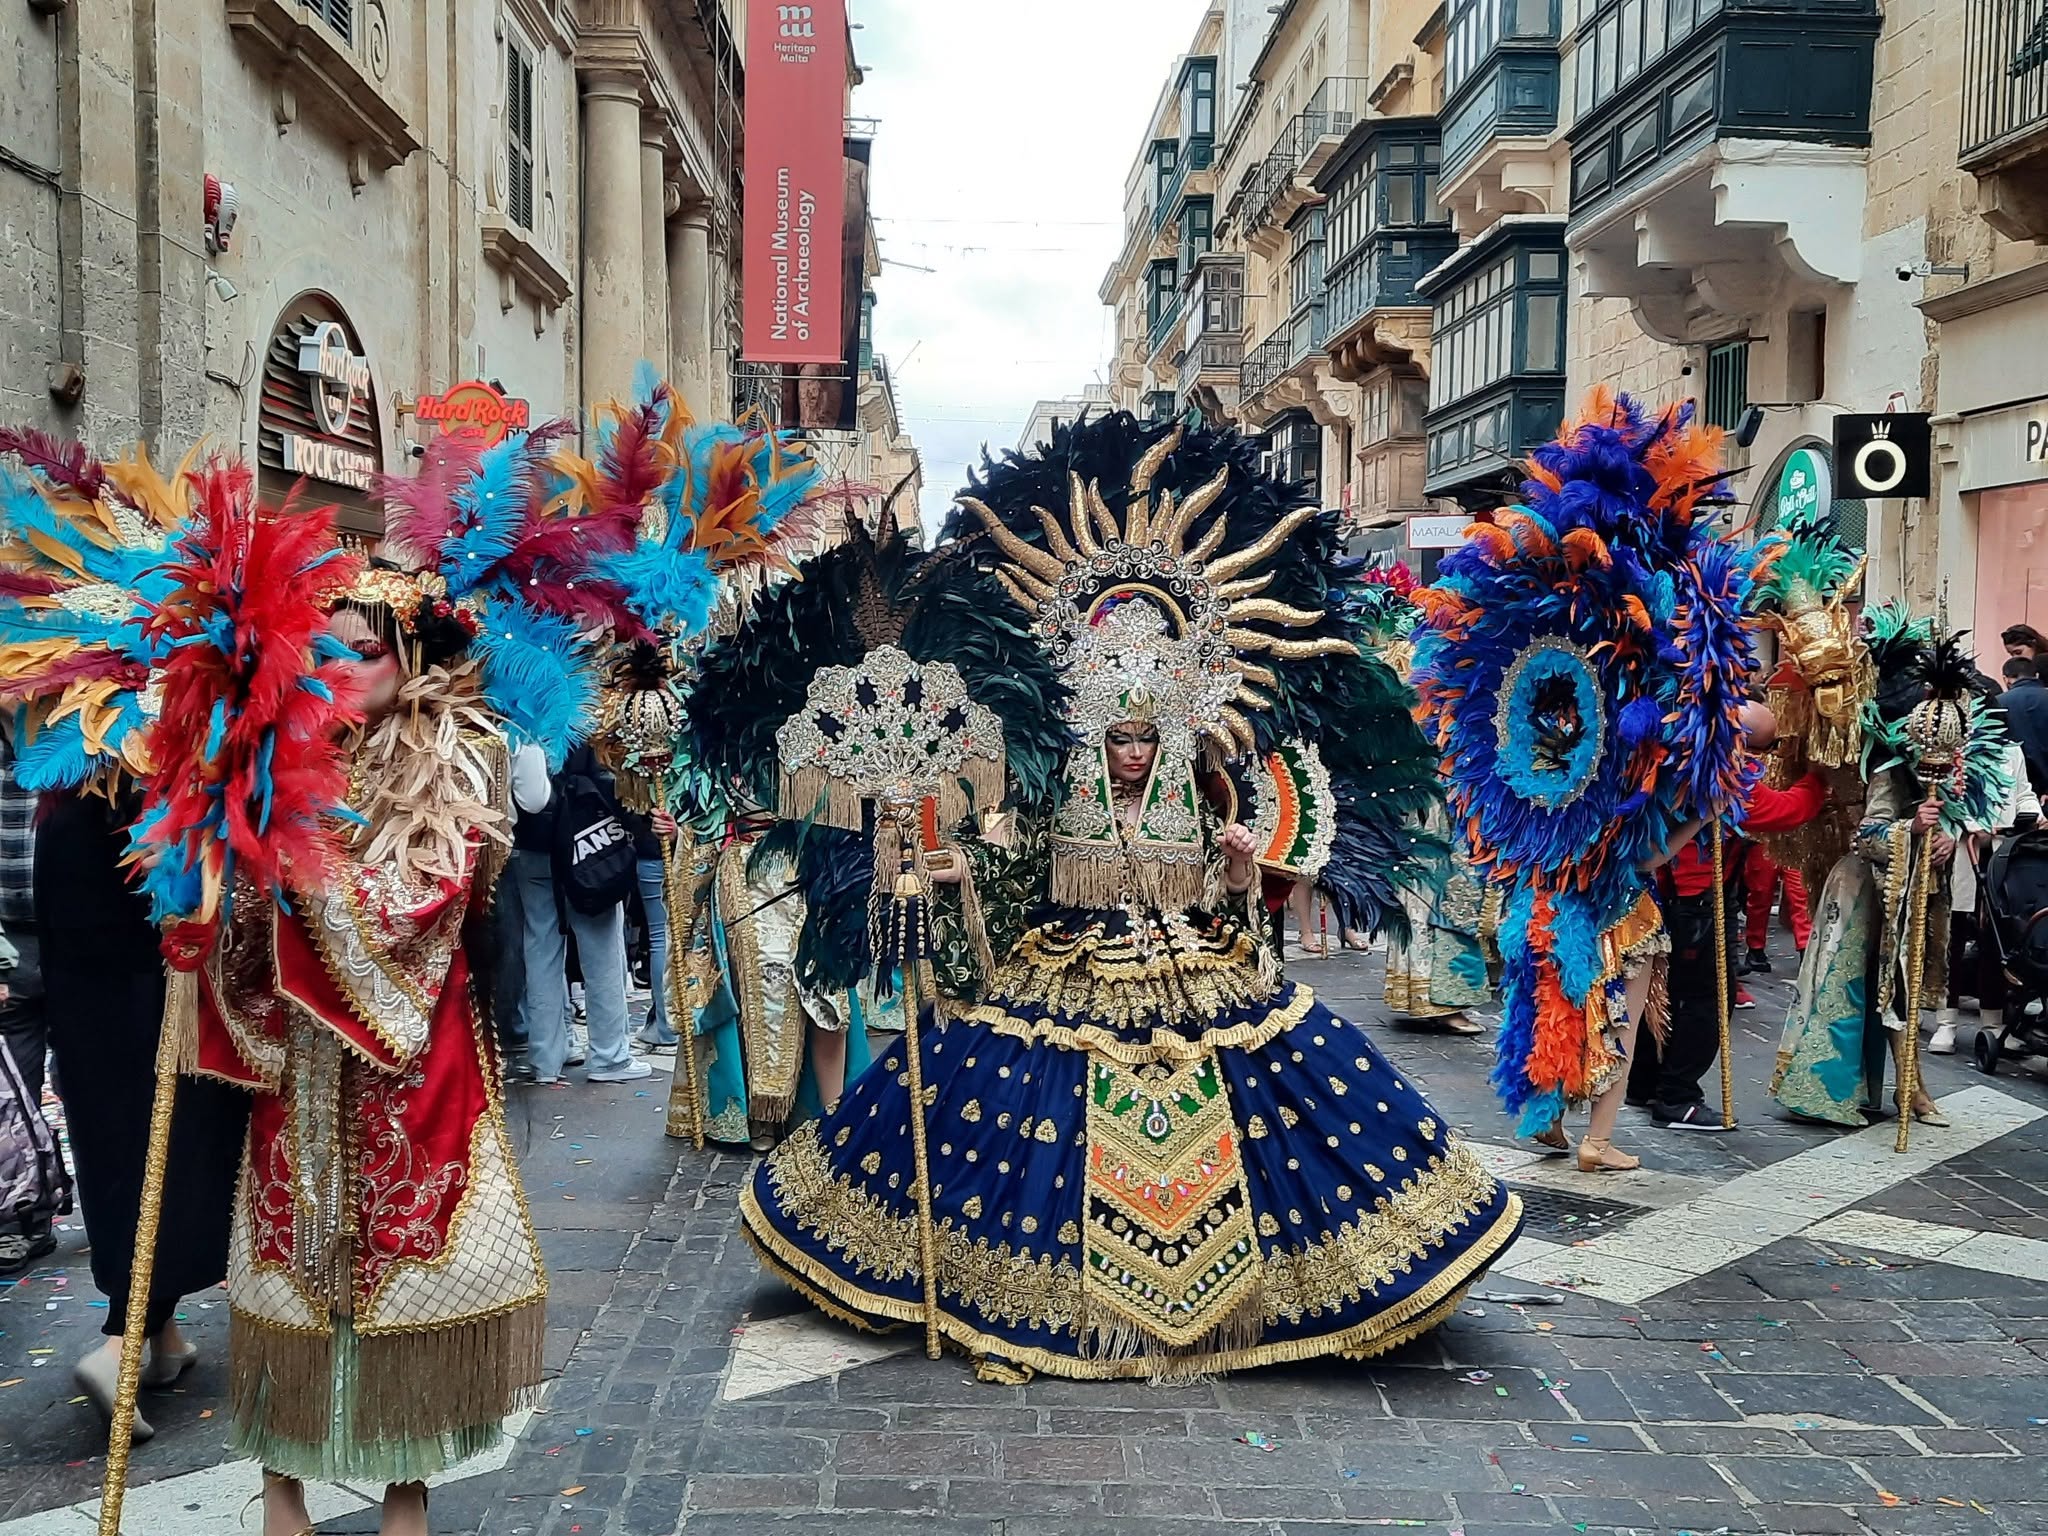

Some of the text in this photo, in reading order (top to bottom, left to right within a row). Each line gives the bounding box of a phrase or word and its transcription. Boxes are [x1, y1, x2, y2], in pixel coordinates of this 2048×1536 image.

[773, 42, 816, 55] Heritage
[780, 53, 809, 63] Malta
[770, 168, 789, 340] National Museum
[790, 189, 816, 341] of Archaeology
[416, 396, 527, 428] Hard Rock
[293, 435, 374, 489] ROCK SHOP
[1411, 526, 1463, 537] MATALA
